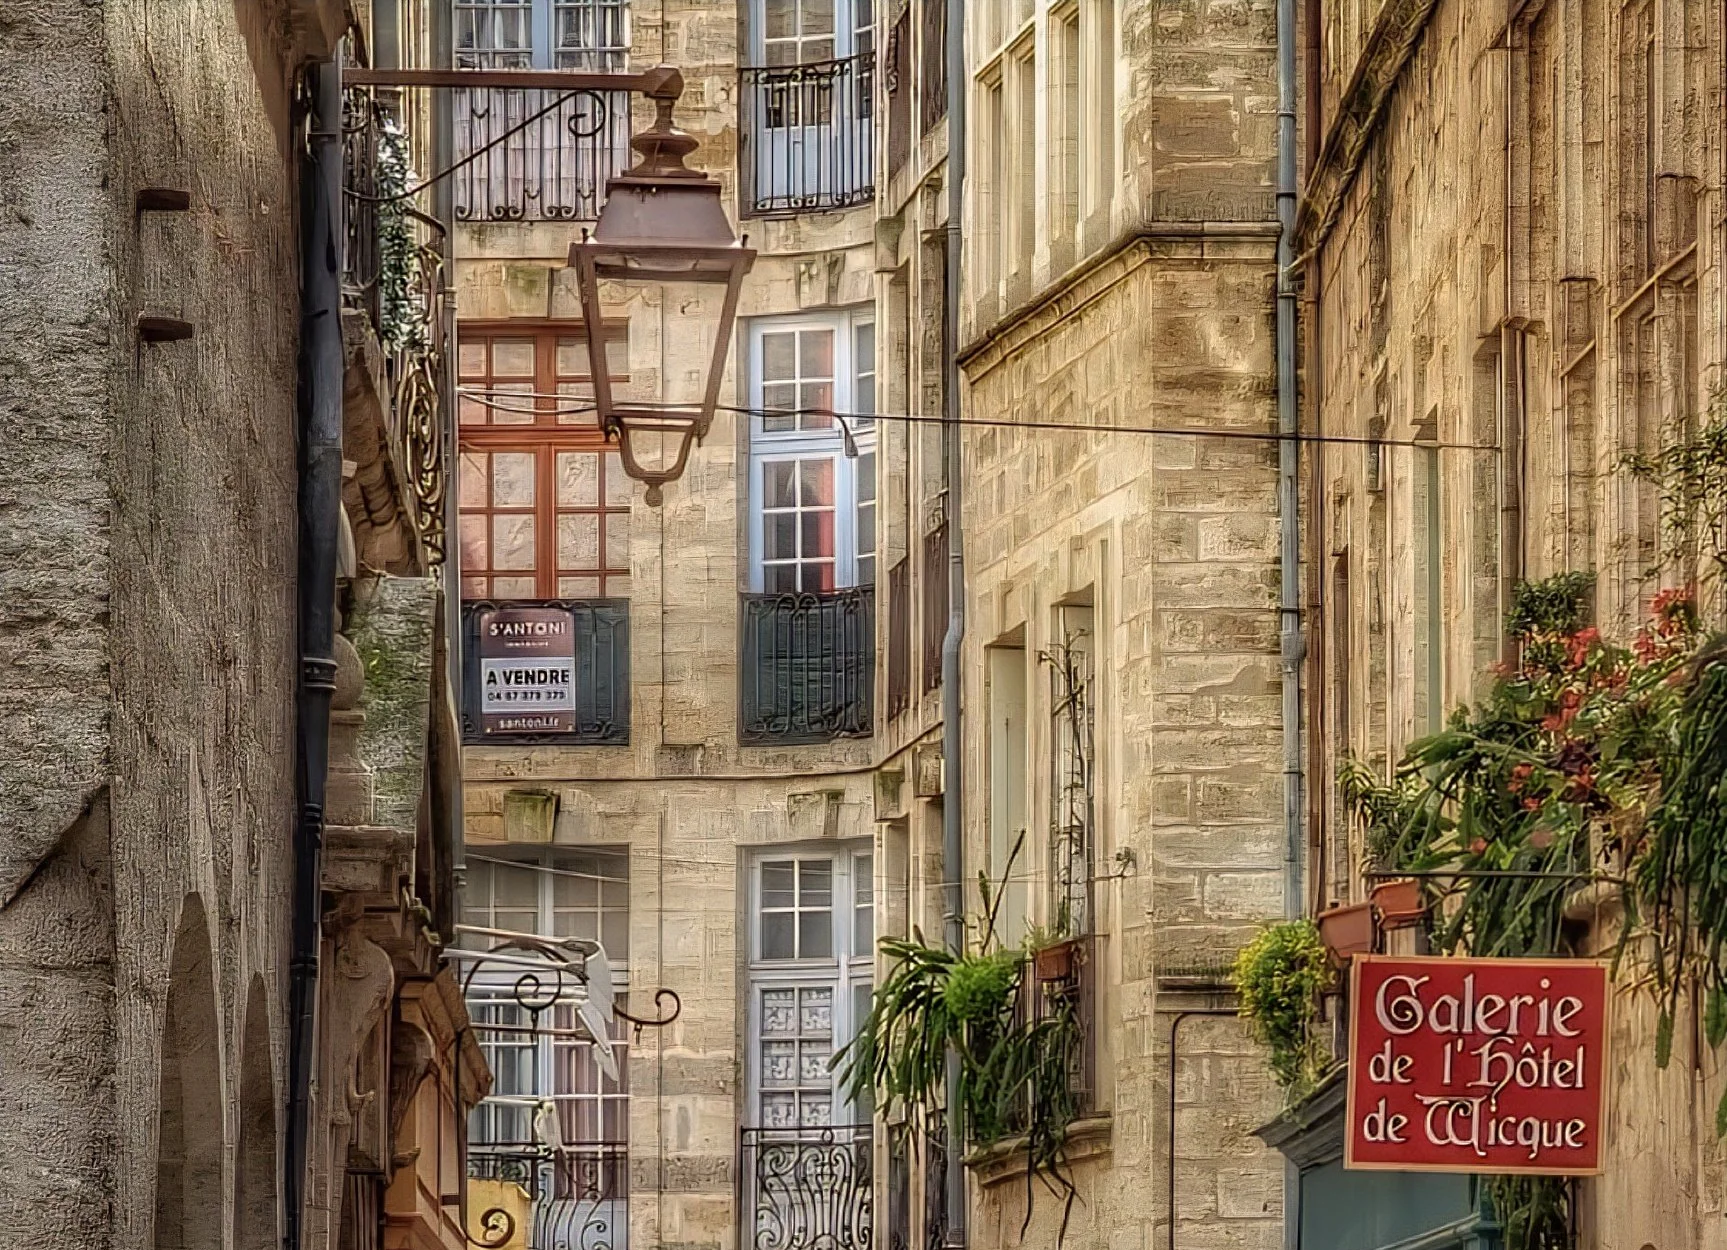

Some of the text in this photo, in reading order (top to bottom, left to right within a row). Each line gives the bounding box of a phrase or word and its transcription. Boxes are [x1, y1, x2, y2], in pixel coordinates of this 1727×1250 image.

[490, 622, 565, 636] S'ANTONI
[487, 669, 570, 685] A VENDRE
[1376, 973, 1583, 1036] Galerie
[1368, 1038, 1415, 1085] de
[1363, 1093, 1587, 1159] de Wicque
